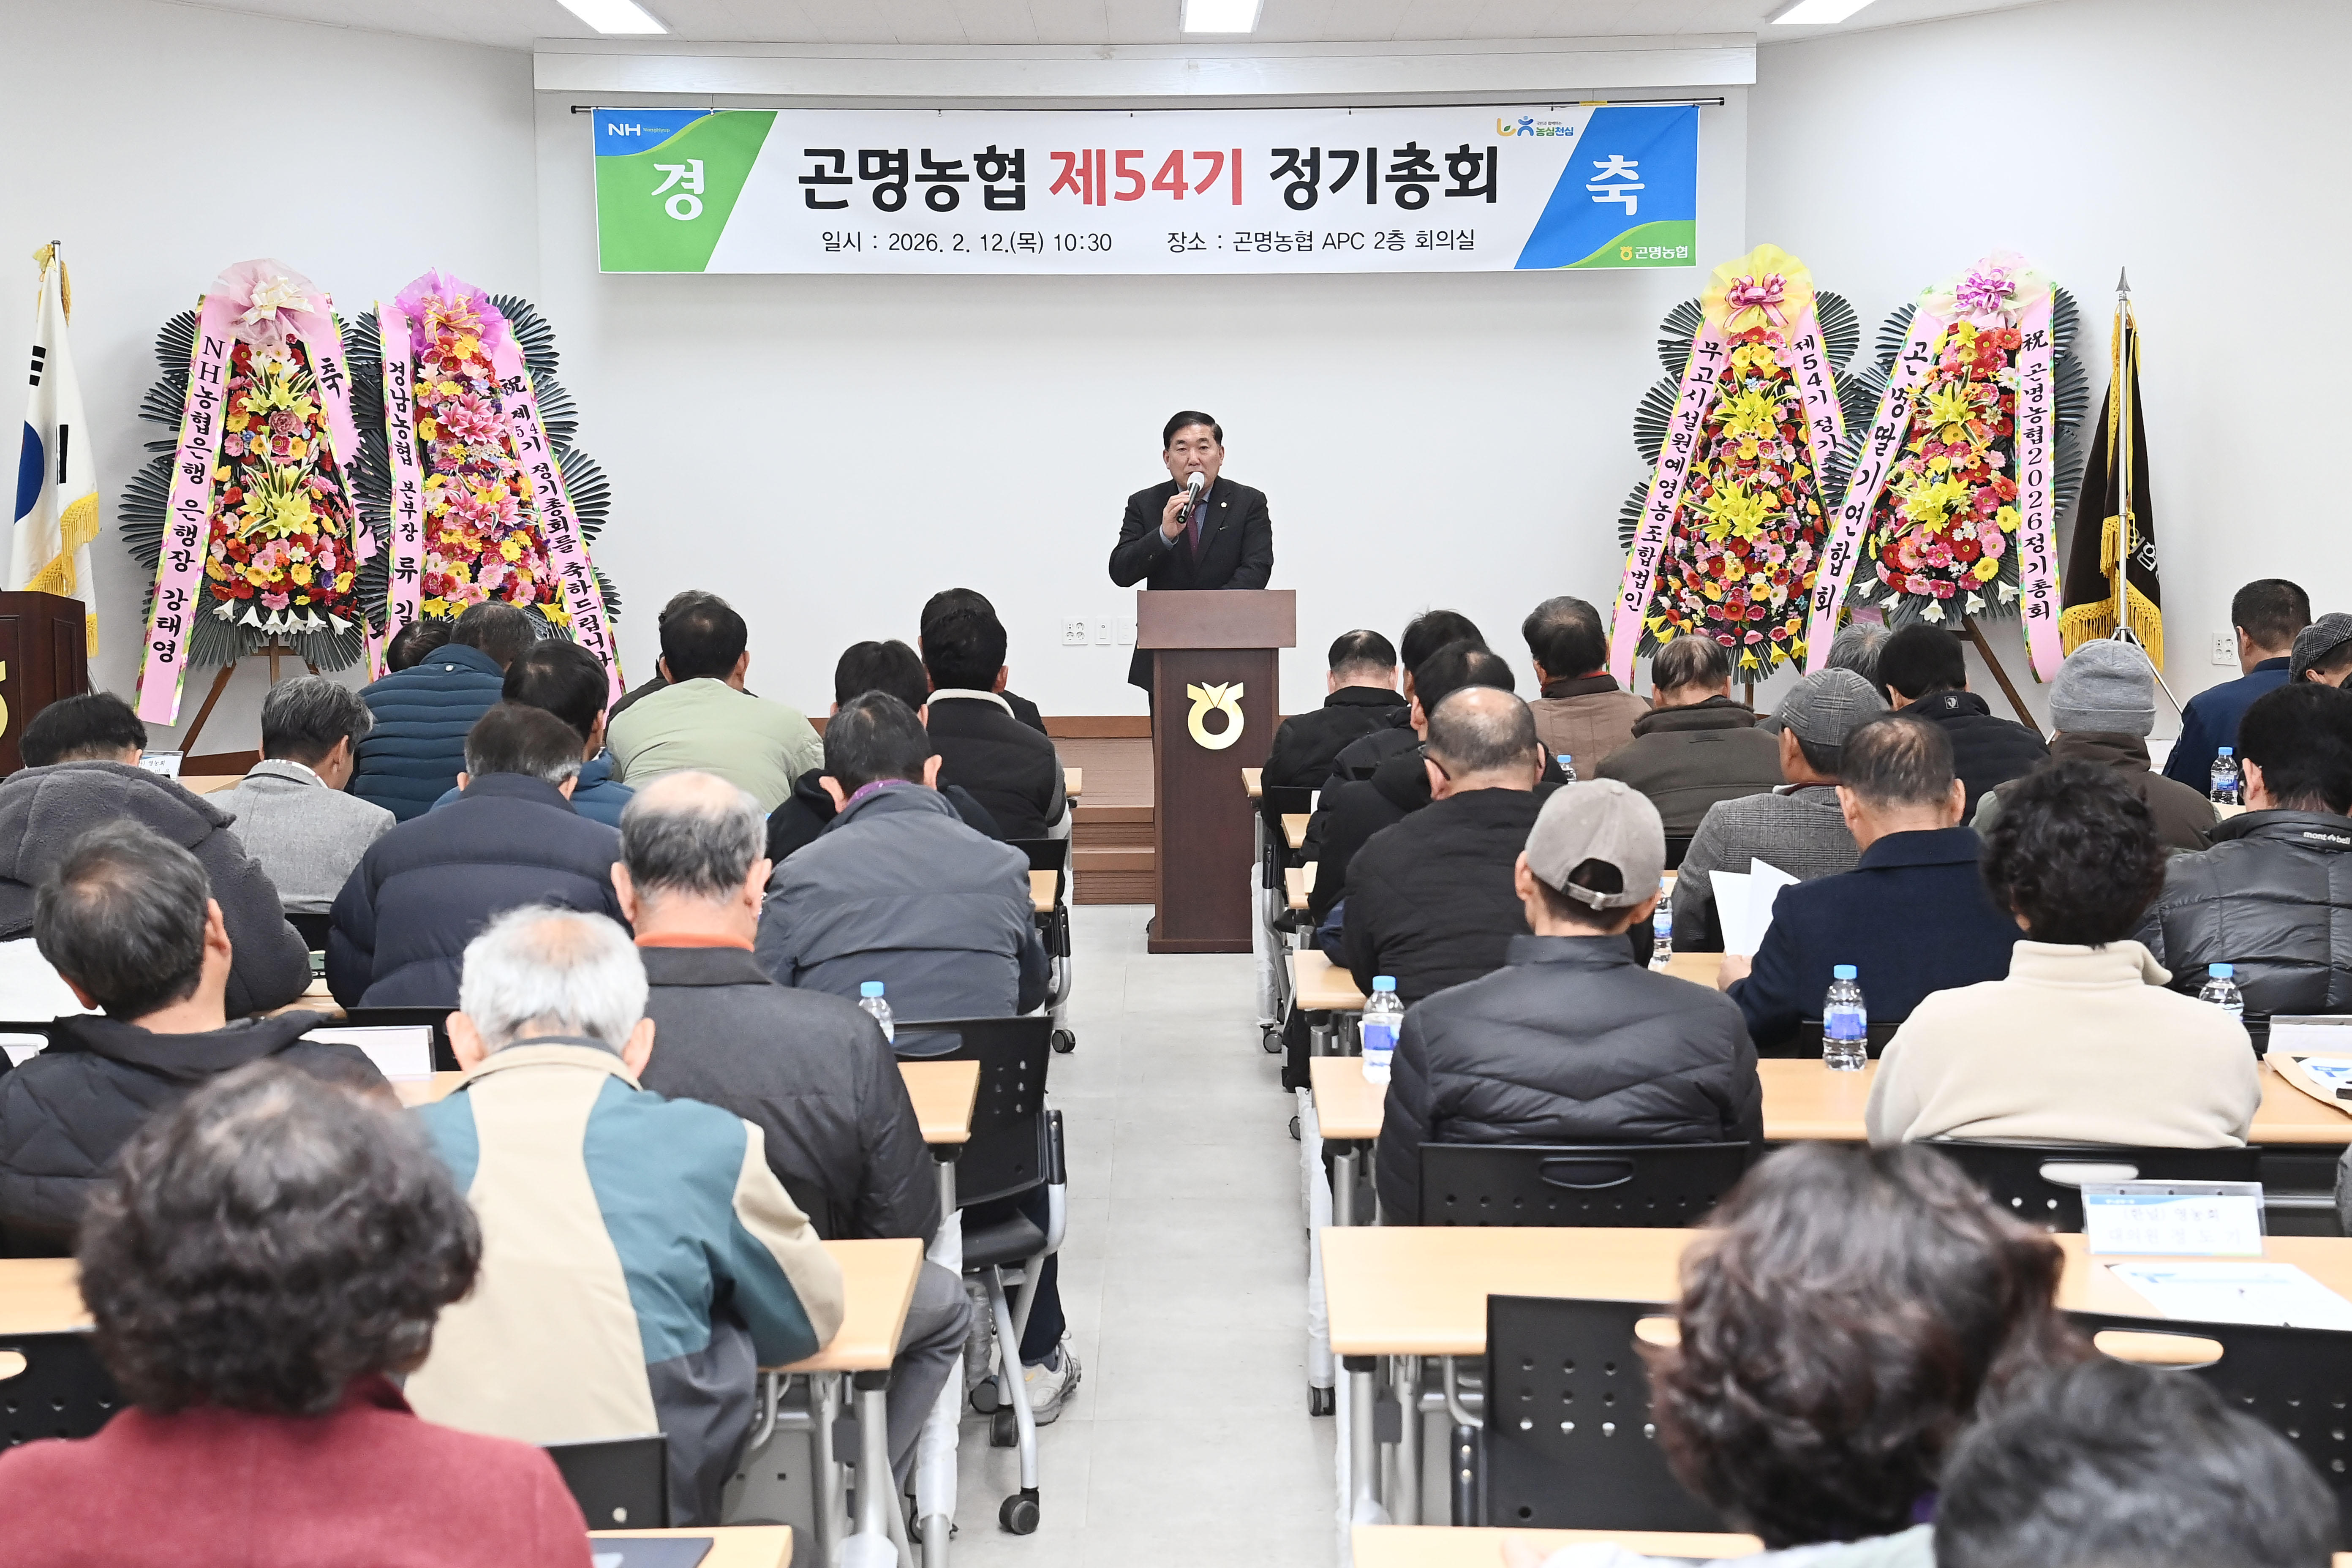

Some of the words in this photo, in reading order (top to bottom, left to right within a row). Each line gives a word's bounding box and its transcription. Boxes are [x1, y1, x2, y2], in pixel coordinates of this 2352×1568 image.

[608, 124, 641, 136] NH
[1535, 126, 1574, 136] 농심천심
[652, 159, 705, 221] 경
[799, 145, 1026, 213] 곤명농협
[1050, 149, 1242, 207] 제54기
[1270, 142, 1497, 211] 정기총회
[1586, 155, 1645, 216] 축
[823, 231, 861, 253] 일시
[889, 234, 943, 253] 2026.
[953, 234, 970, 253] 2.
[981, 231, 1044, 254] 12.(목)
[1055, 234, 1112, 252] 10:30
[1168, 232, 1207, 253] 장소
[1233, 231, 1313, 253] 곤명농협
[1323, 232, 1365, 250] APC
[1375, 230, 1406, 251] 2층
[1416, 229, 1474, 251] 회의실
[1635, 245, 1688, 259] 곤명농협
[1794, 335, 1827, 405] 제54기
[2022, 330, 2048, 352] 祝
[320, 357, 344, 398] 축
[499, 376, 526, 398] 祝
[183, 336, 226, 485] NH농협은행
[389, 360, 413, 466] 경남농협
[512, 404, 541, 453] 제54기
[1625, 340, 1723, 612] 무고시설원예영농조합법인
[168, 499, 205, 572] 은행장
[398, 480, 419, 542] 본부장
[530, 462, 575, 554] 정기총회를
[152, 588, 189, 663] 강태영
[2303, 832, 2327, 841] mont
[2336, 835, 2351, 844] bell
